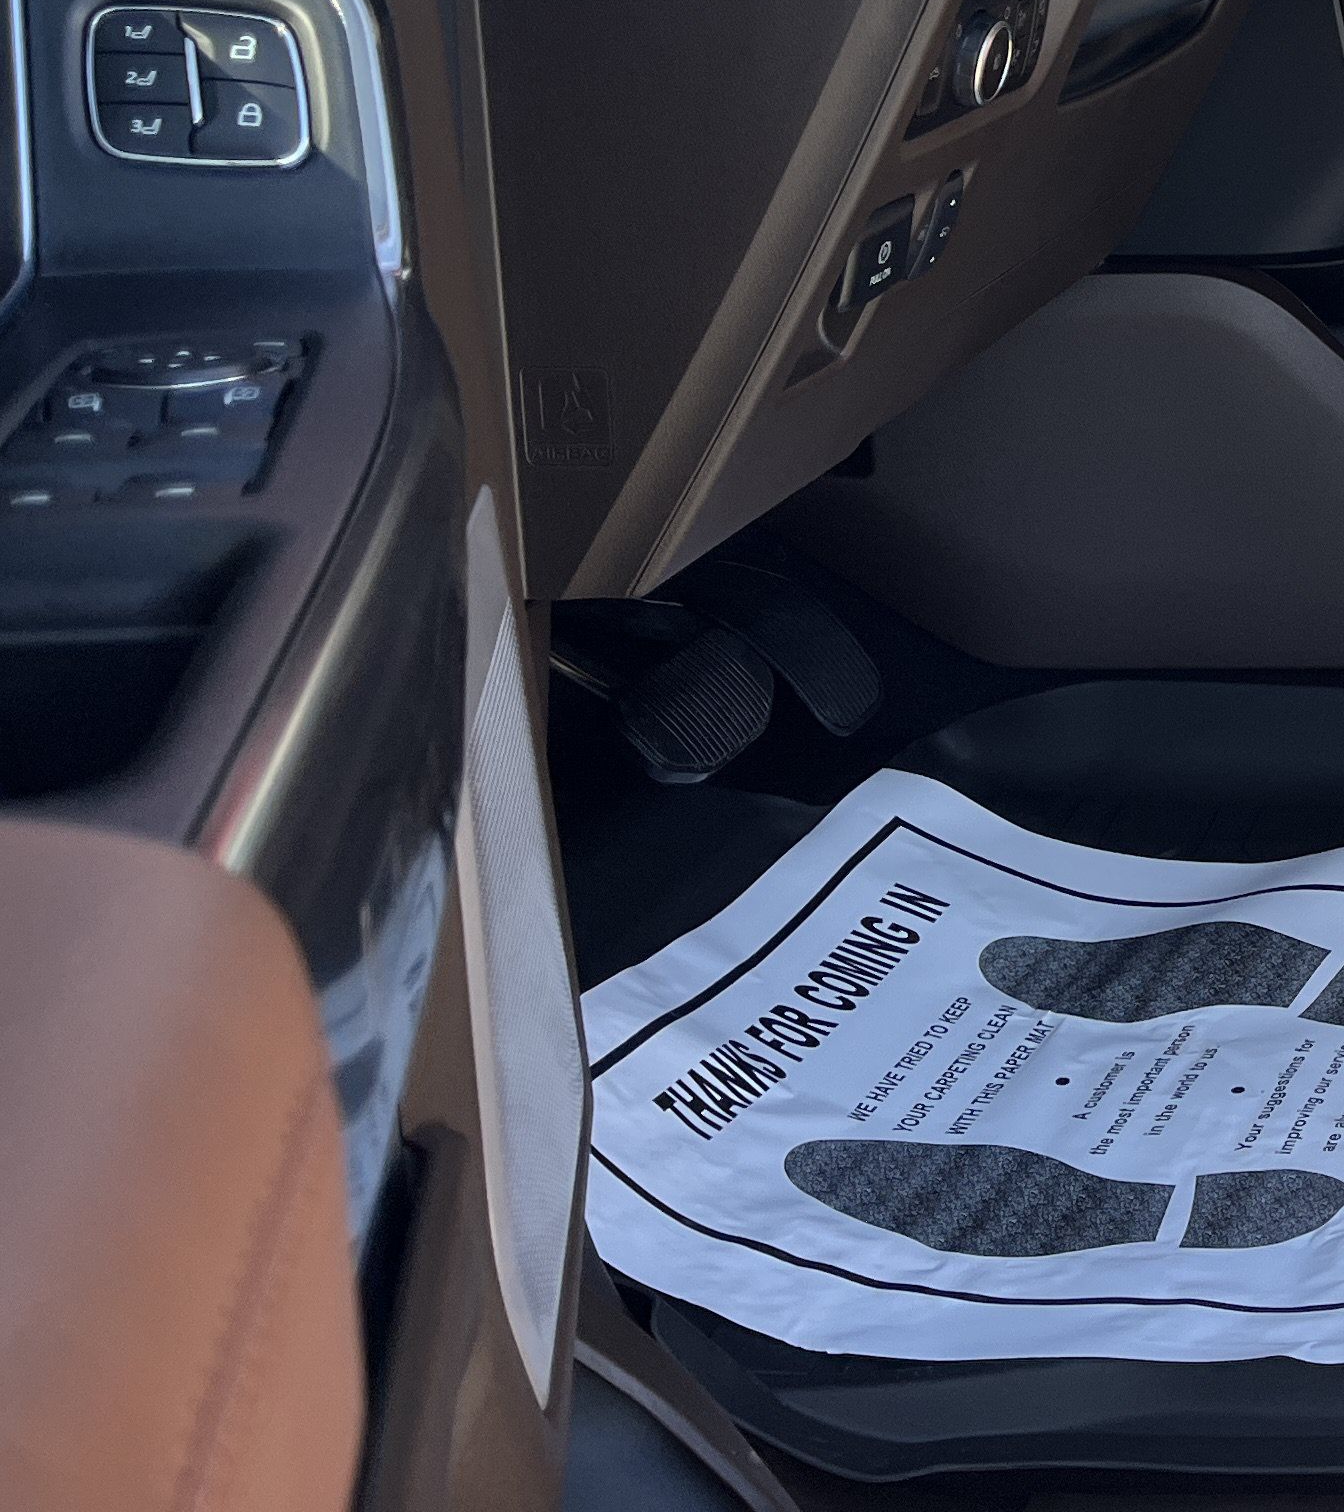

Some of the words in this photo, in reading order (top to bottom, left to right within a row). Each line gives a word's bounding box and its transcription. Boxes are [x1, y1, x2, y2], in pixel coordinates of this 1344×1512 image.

[125, 71, 137, 85] 2
[130, 119, 142, 133] 3
[652, 1039, 787, 1140] THANKS
[744, 1004, 839, 1063] FOR
[794, 916, 920, 1011] COMING
[879, 883, 951, 923] IN
[847, 1102, 878, 1122] WE
[865, 1071, 906, 1103] HAVE
[894, 1040, 934, 1071] TRIED
[923, 1024, 949, 1039] TO
[938, 996, 972, 1024] KEEP
[892, 1102, 935, 1132] YOUR
[924, 1042, 986, 1101] CARPETING
[977, 1004, 1018, 1040] CLEAN
[945, 1107, 983, 1135] WITH
[971, 1082, 1004, 1104] THIS
[993, 1045, 1036, 1081] PAPER
[1024, 1020, 1055, 1044] MAT
[1072, 1111, 1092, 1120] A
[1084, 1062, 1127, 1109] customer
[1115, 1051, 1135, 1060] is
[1089, 1138, 1114, 1155] the
[1107, 1108, 1136, 1135] most
[1123, 1057, 1171, 1105] important
[1163, 1024, 1196, 1056] person
[1142, 1124, 1165, 1136] in
[1154, 1104, 1178, 1122] the
[1170, 1074, 1199, 1100] world
[1189, 1062, 1208, 1071] to
[1234, 1123, 1265, 1151] Your
[1258, 1055, 1306, 1120] suggestions
[1294, 1038, 1316, 1052] for
[1275, 1096, 1324, 1155] improving
[1314, 1077, 1333, 1094] our
[1323, 1133, 1342, 1153] are
